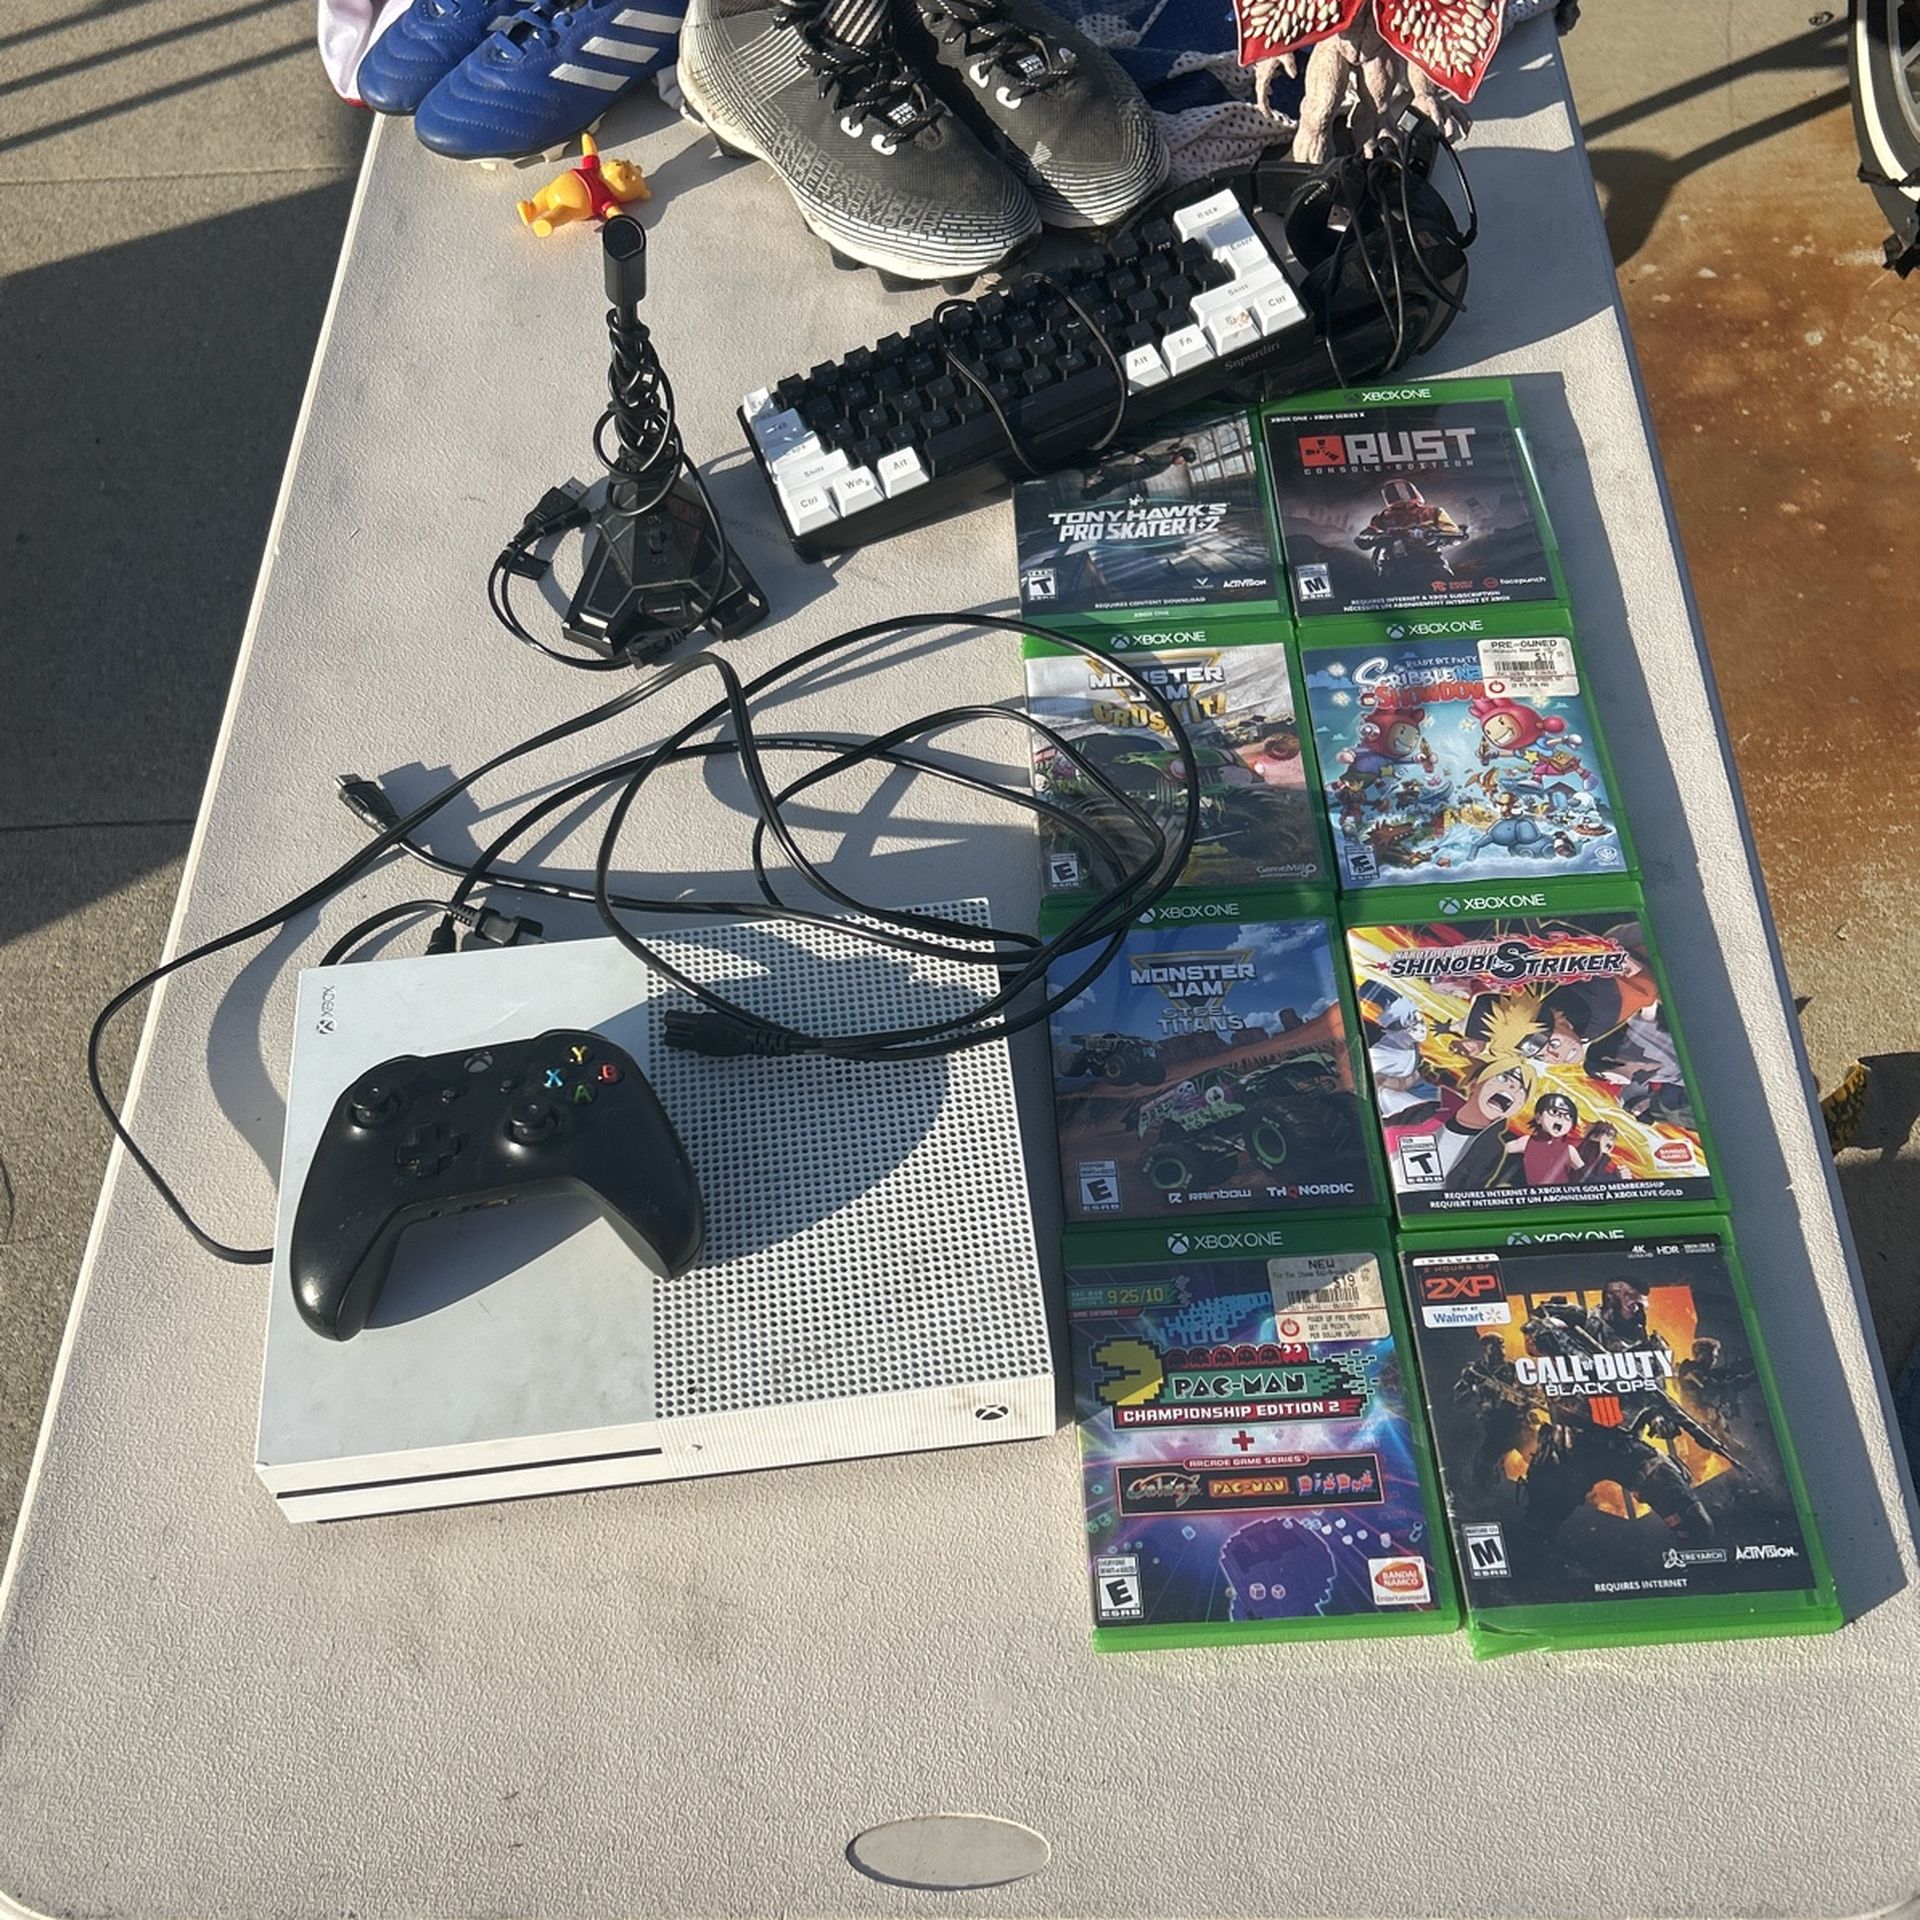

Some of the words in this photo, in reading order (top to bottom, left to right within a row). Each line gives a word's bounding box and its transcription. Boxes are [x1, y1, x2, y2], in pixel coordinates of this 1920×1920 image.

[1133, 356, 1149, 368] Alt
[1362, 390, 1401, 402] XBOX
[1401, 388, 1431, 400] ONE
[1344, 428, 1476, 464] RUST
[892, 458, 908, 470] Alt
[1303, 465, 1381, 475] CONSOLE
[1395, 460, 1474, 470] EDITION
[800, 495, 819, 508] Ctrl
[1048, 510, 1125, 525] TONY
[1126, 502, 1228, 521] HAWK'S
[1059, 523, 1104, 542] PRO
[1105, 517, 1186, 540] SKATER
[1031, 577, 1052, 594] T
[1223, 578, 1267, 588] ACTIVISION
[1304, 577, 1328, 593] M
[1408, 622, 1450, 635] XBOX
[1450, 620, 1484, 632] ONE
[1132, 634, 1173, 646] XBOX
[1173, 631, 1206, 643] ONE
[1089, 666, 1226, 690] MOSTER
[1053, 863, 1076, 881] E
[1463, 896, 1510, 910] XBOX
[1509, 893, 1547, 907] ONE
[1159, 905, 1204, 919] XBOX
[1204, 903, 1240, 916] ONE
[1390, 956, 1494, 976] SHINOBI
[1490, 942, 1627, 979] STRIKER
[1130, 963, 1256, 984] MONSTER
[1168, 981, 1224, 998] JAM
[321, 985, 336, 1017] XBOX
[1162, 1005, 1236, 1018] STEEL
[1158, 1015, 1244, 1035] TITANS
[571, 1045, 588, 1065] Y
[544, 1068, 563, 1088] X
[574, 1084, 593, 1103] A
[1409, 1153, 1433, 1174] T
[1086, 1179, 1113, 1202] E
[1299, 1183, 1355, 1196] NORDIC
[1444, 1191, 1485, 1199] REQUIRES
[1487, 1189, 1528, 1197] INTERNET
[1538, 1186, 1562, 1194] XBOX
[1608, 1181, 1665, 1190] MEMBERSHIP
[1472, 1198, 1514, 1207] INTERNET
[1543, 1193, 1604, 1202] ABONNEMENT
[1614, 1190, 1638, 1199] XBOX
[1639, 1189, 1657, 1197] LIVE
[1658, 1188, 1683, 1196] GOLD
[1194, 1232, 1244, 1250] XBOX
[1244, 1231, 1284, 1247] ONE
[1656, 1245, 1680, 1255] HDR
[1425, 1274, 1496, 1299] 2XP
[1433, 1312, 1485, 1323] Walmart
[1515, 1354, 1590, 1385] CALL
[1593, 1350, 1673, 1381] DUTY
[1171, 1370, 1308, 1399] PAC-MAN
[1545, 1382, 1612, 1397] BLACK
[1616, 1379, 1657, 1393] OPS
[1123, 1404, 1252, 1422] CHAMPIONSHIP
[1256, 1401, 1325, 1416] EDITION
[1328, 1401, 1341, 1412] 2
[1189, 1459, 1231, 1468] ARCADE
[1233, 1456, 1261, 1466] GAME
[1264, 1455, 1302, 1464] SERIES
[1212, 1480, 1284, 1494] PAC-MAN
[1471, 1538, 1503, 1567] M
[1735, 1545, 1796, 1561] ACTIVISION
[1382, 1570, 1418, 1578] BANDAI
[1384, 1579, 1418, 1587] NAMCO
[1106, 1578, 1134, 1607] E
[1594, 1580, 1641, 1592] REQUIRES
[1642, 1578, 1688, 1589] INTERNET
